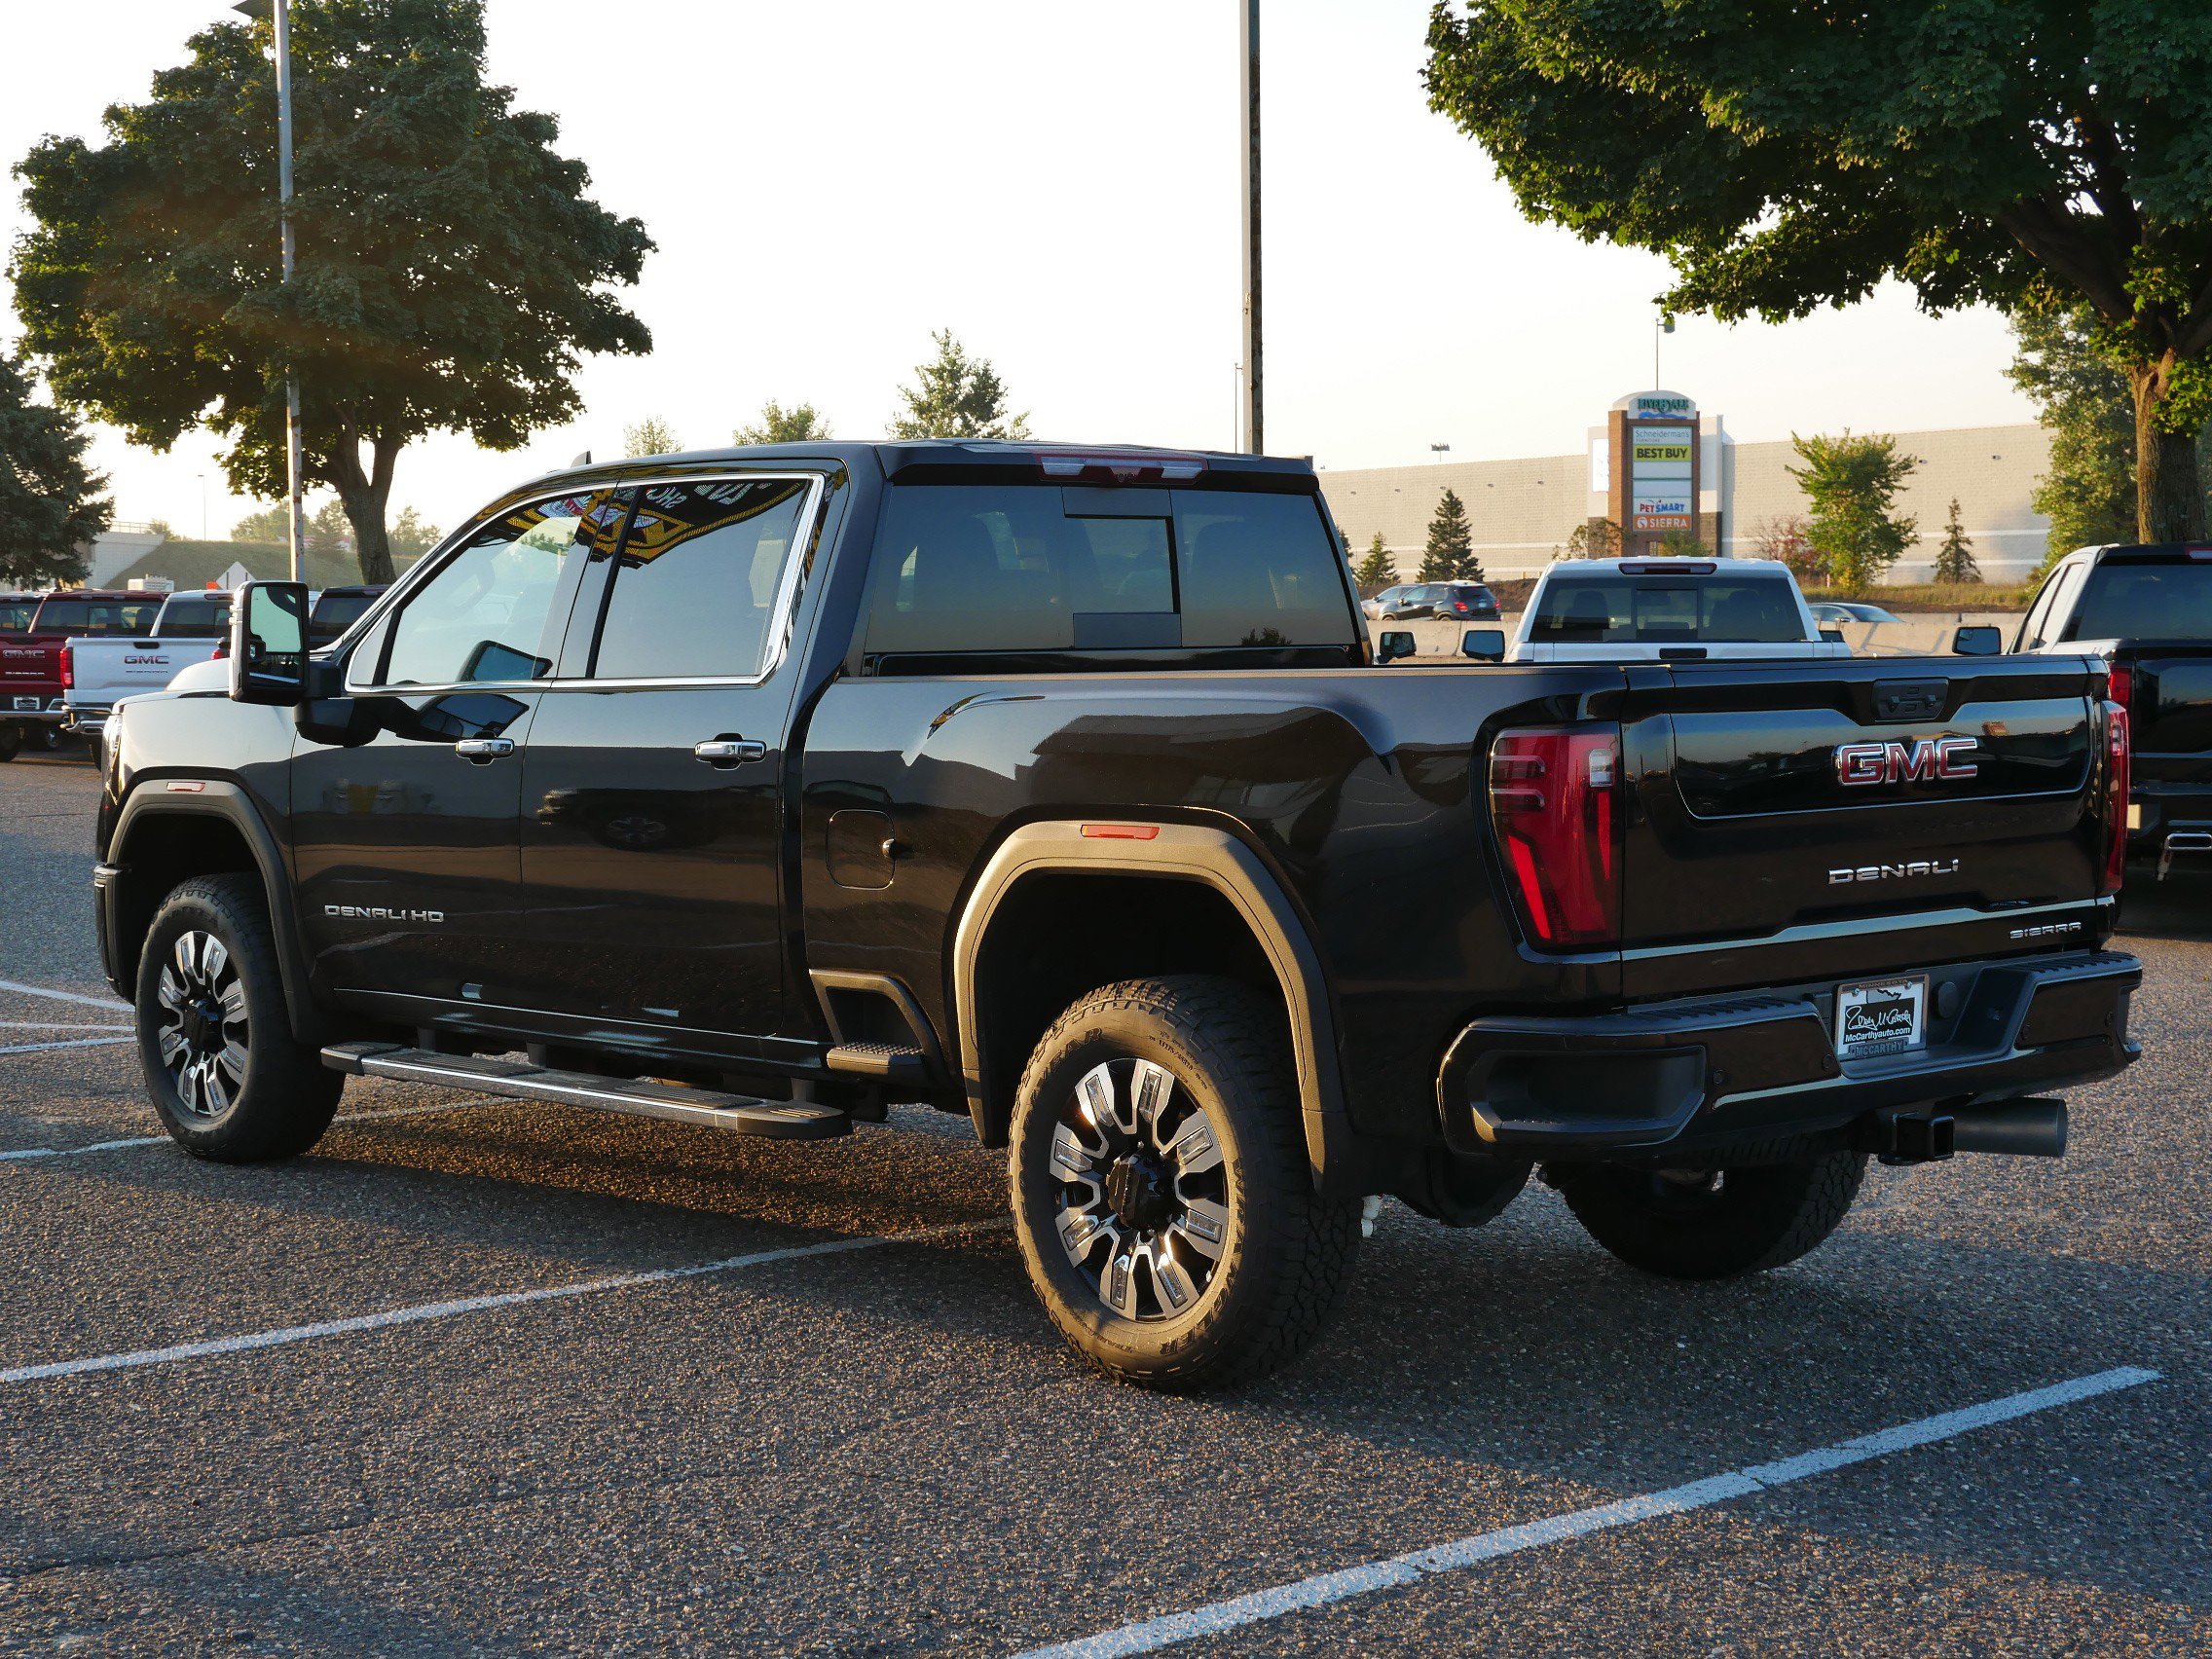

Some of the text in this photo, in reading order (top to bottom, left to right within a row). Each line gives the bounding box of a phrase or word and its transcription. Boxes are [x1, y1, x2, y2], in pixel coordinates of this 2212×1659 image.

[1635, 429, 1689, 438] Schneiderman's
[1637, 448, 1687, 459] BEST BUY
[1649, 517, 1687, 528] SIERRA
[2, 649, 45, 658] GMC
[124, 655, 169, 664] GMC
[1831, 737, 1978, 787] GMC
[1828, 859, 1959, 884] DENALI
[324, 904, 444, 923] DENALI HD
[2009, 921, 2082, 940] SIERRA
[1845, 1027, 1910, 1042] McCarthyauto.com
